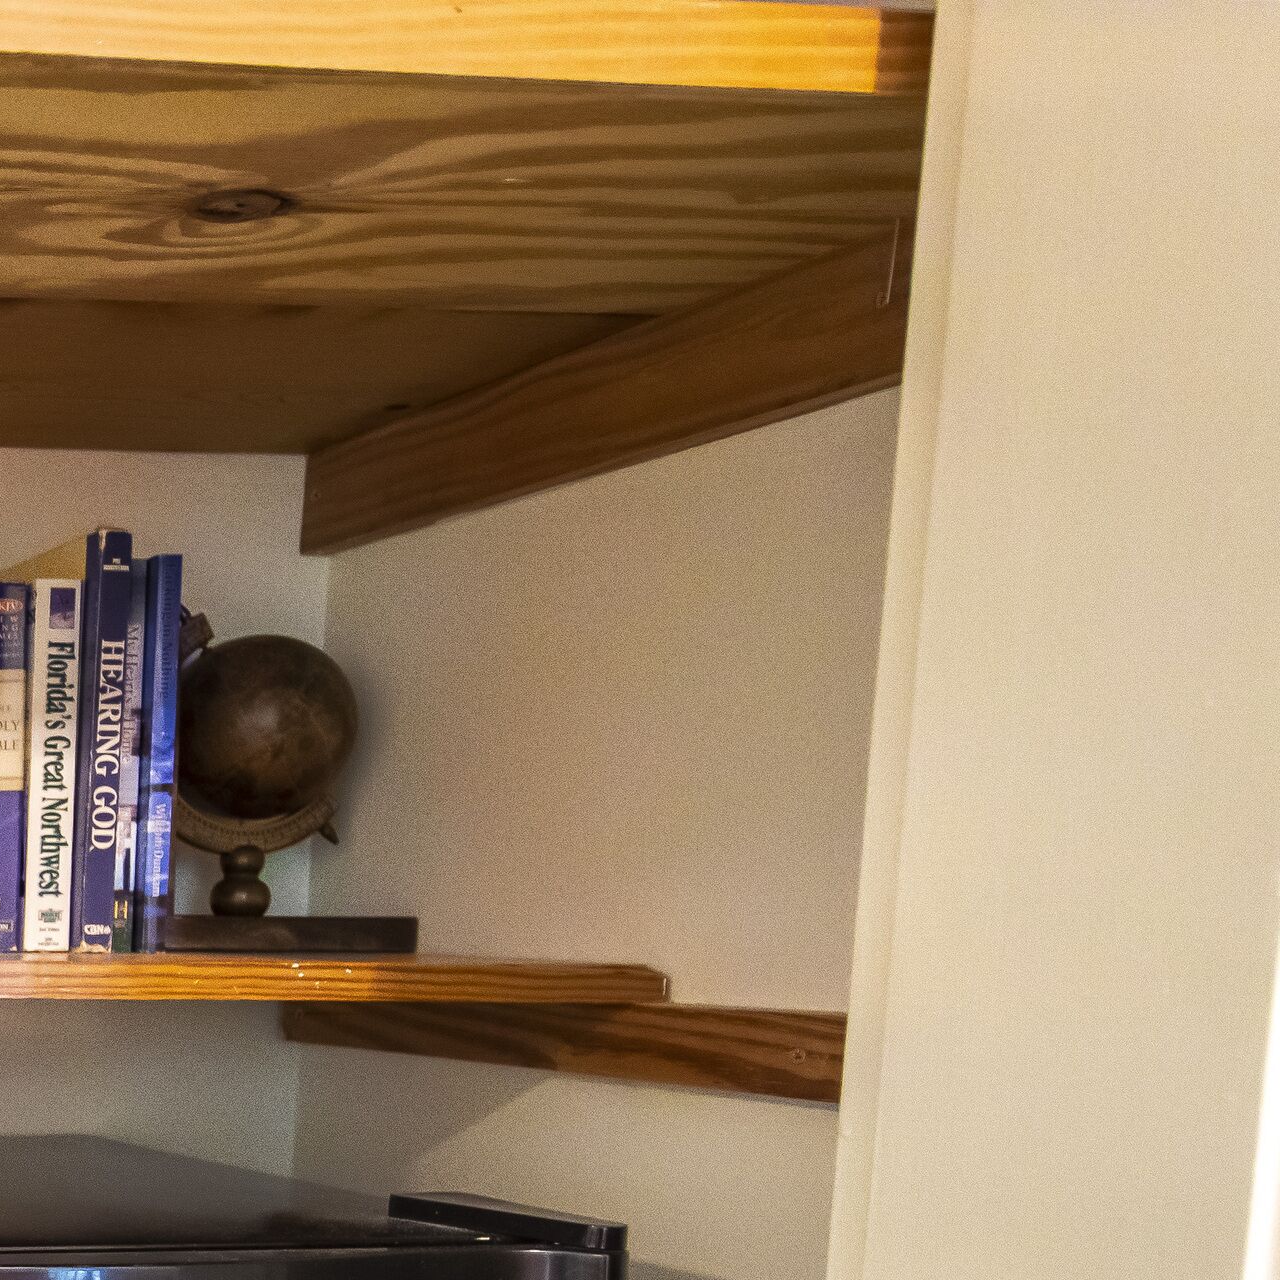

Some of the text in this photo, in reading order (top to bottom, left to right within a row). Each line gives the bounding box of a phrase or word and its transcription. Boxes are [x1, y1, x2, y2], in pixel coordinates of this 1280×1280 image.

[45, 641, 77, 729] Florida's
[94, 639, 125, 777] HEARING
[42, 734, 71, 791] Great
[38, 797, 69, 898] Northwest
[91, 785, 118, 850] GOD
